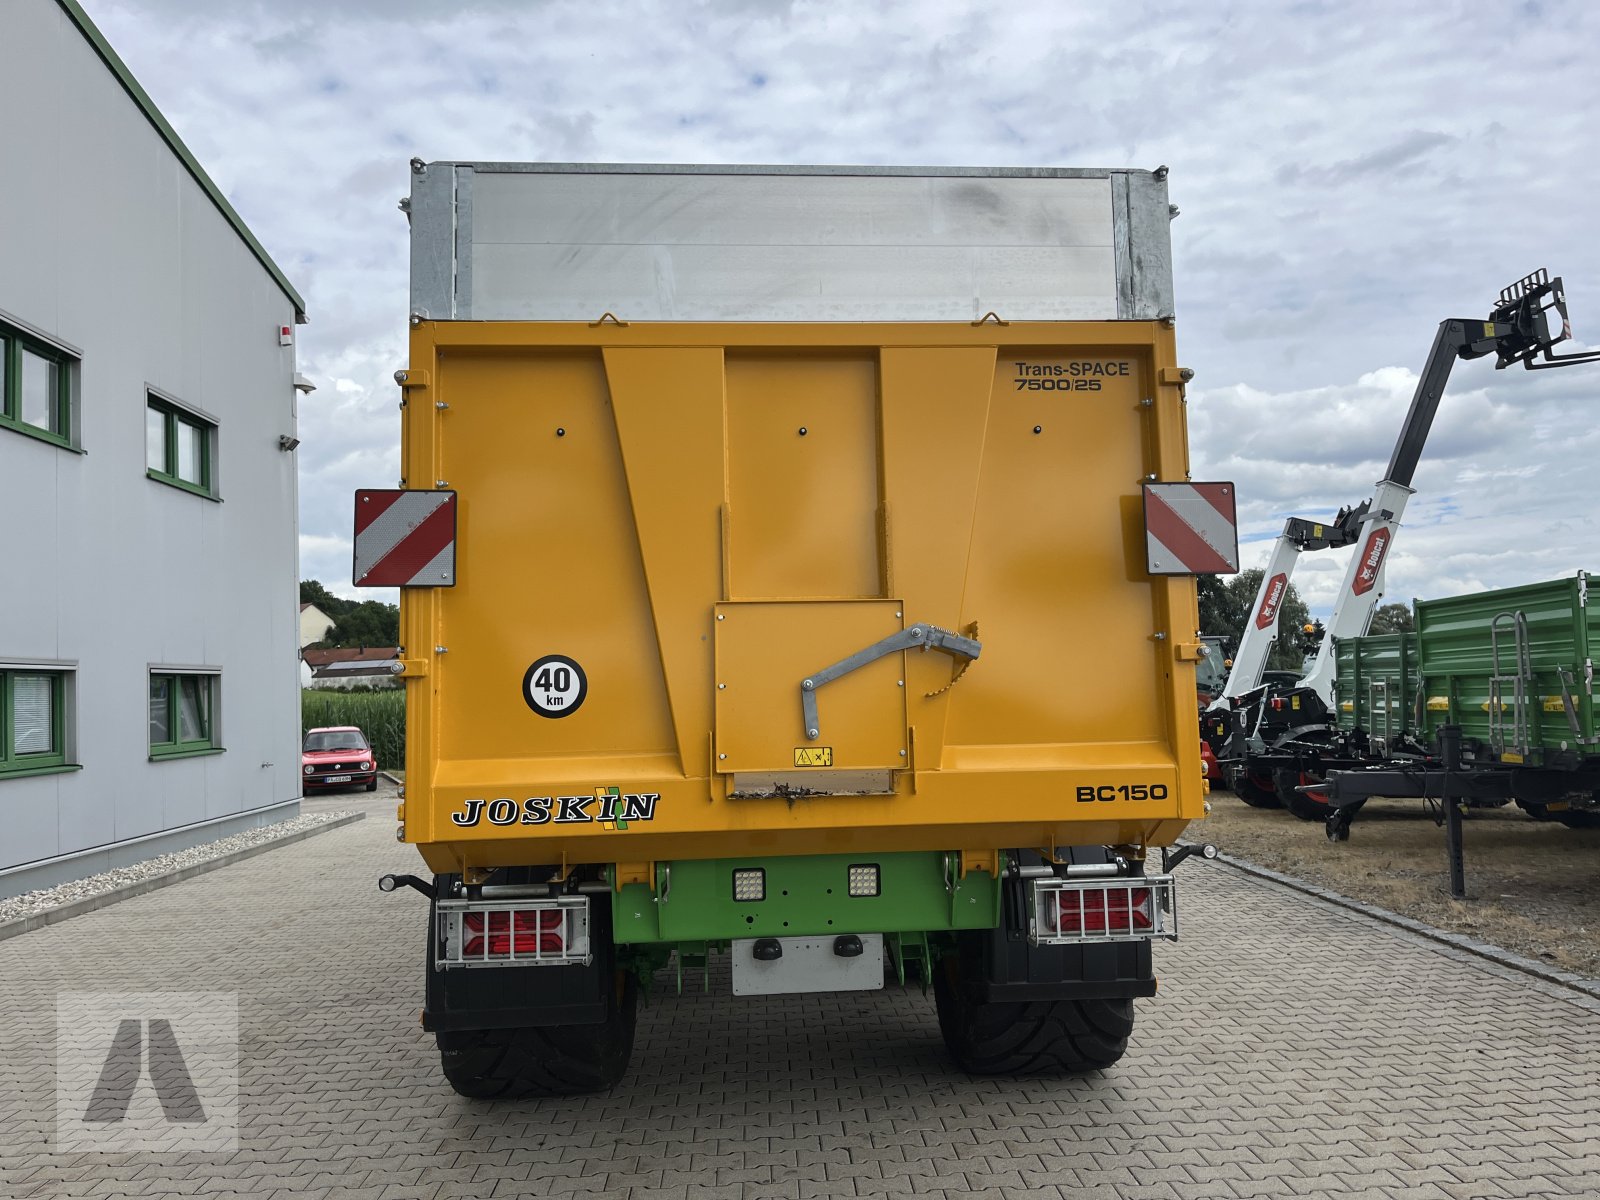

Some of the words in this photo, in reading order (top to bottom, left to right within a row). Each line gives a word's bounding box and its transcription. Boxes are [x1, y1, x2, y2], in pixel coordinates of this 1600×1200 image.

[1015, 362, 1130, 376] Trans-SPACE
[1014, 379, 1102, 391] 7500/25
[1367, 537, 1385, 567] Bobcat
[535, 667, 571, 693] 40
[546, 694, 564, 706] km
[1076, 784, 1168, 803] BC150
[451, 793, 662, 828] JOSKIN
